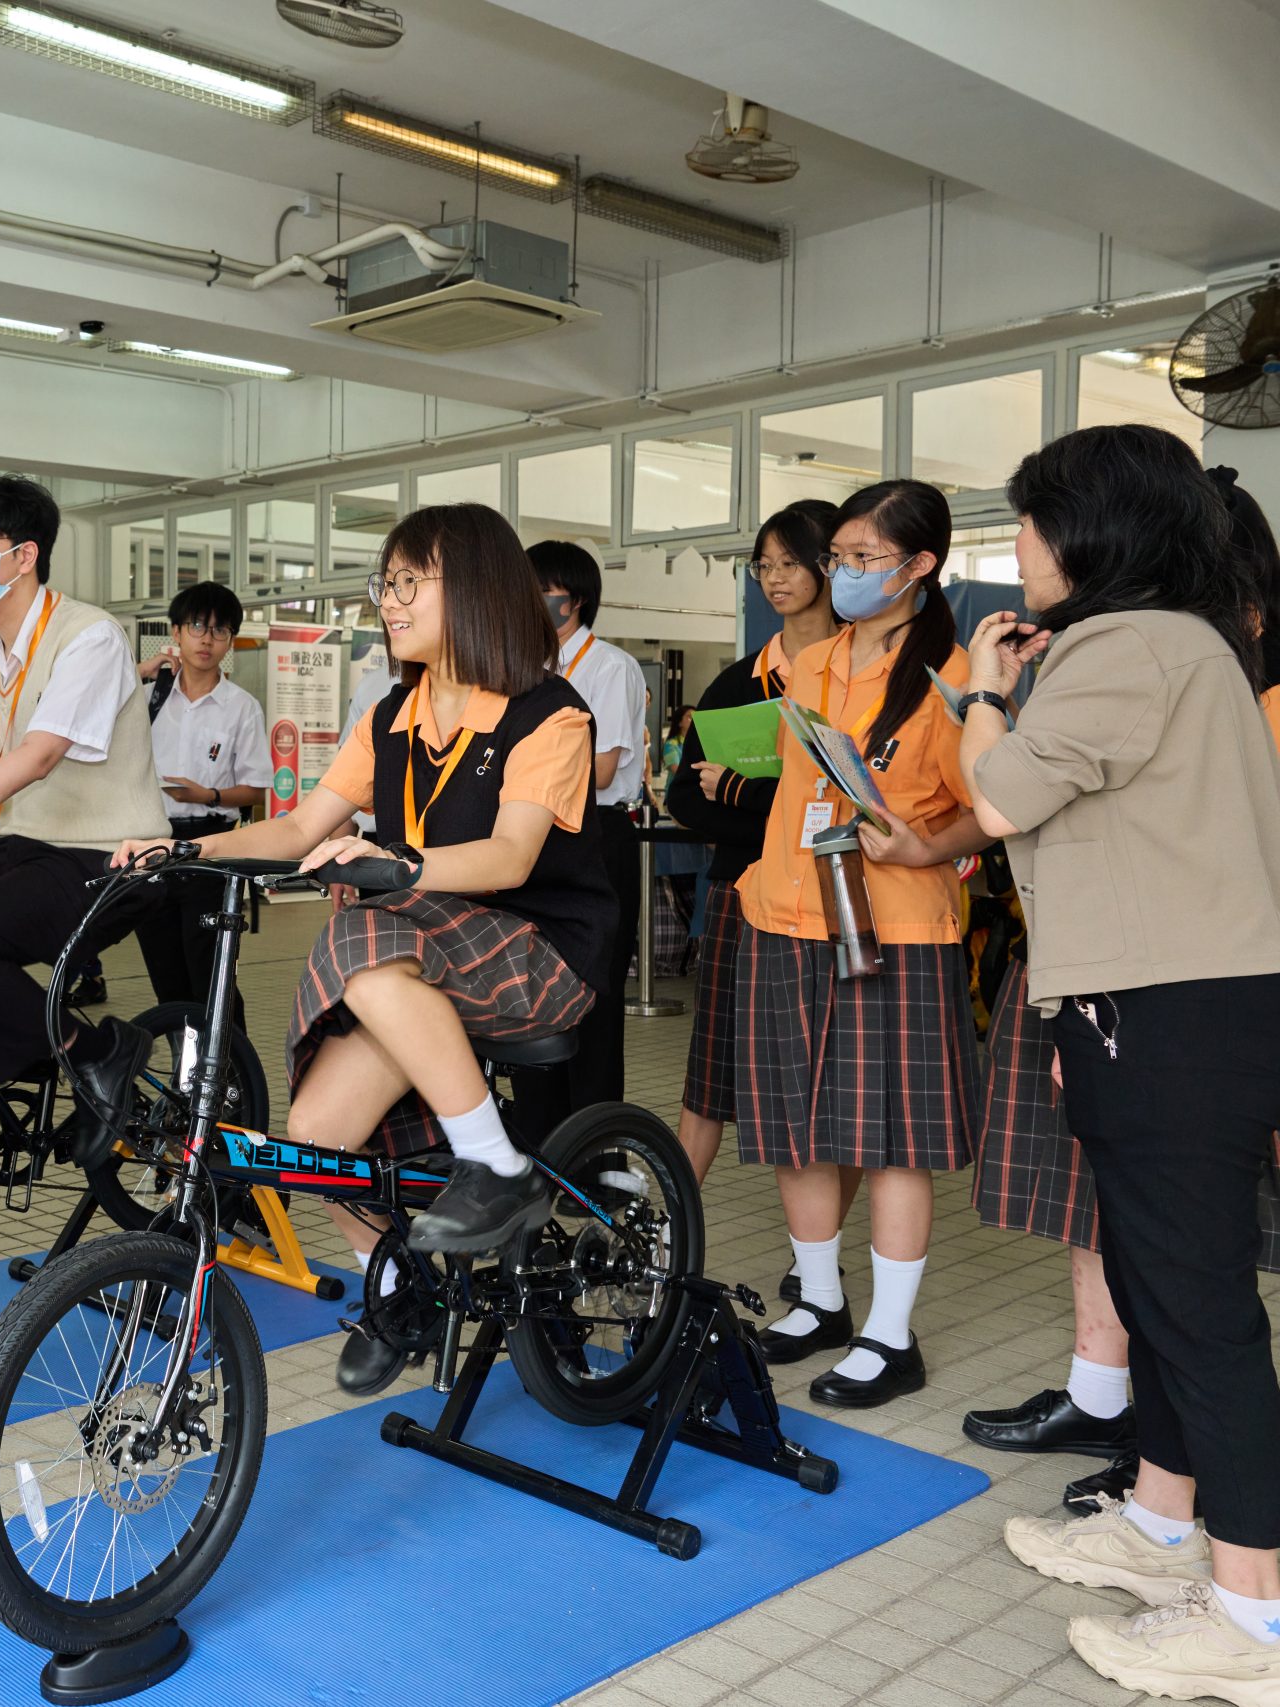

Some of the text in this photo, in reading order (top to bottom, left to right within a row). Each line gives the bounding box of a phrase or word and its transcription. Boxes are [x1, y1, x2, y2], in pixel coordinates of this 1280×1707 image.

[291, 651, 333, 667] 廉政公署
[297, 666, 314, 677] ICAC
[234, 1139, 357, 1178] VELOCE
